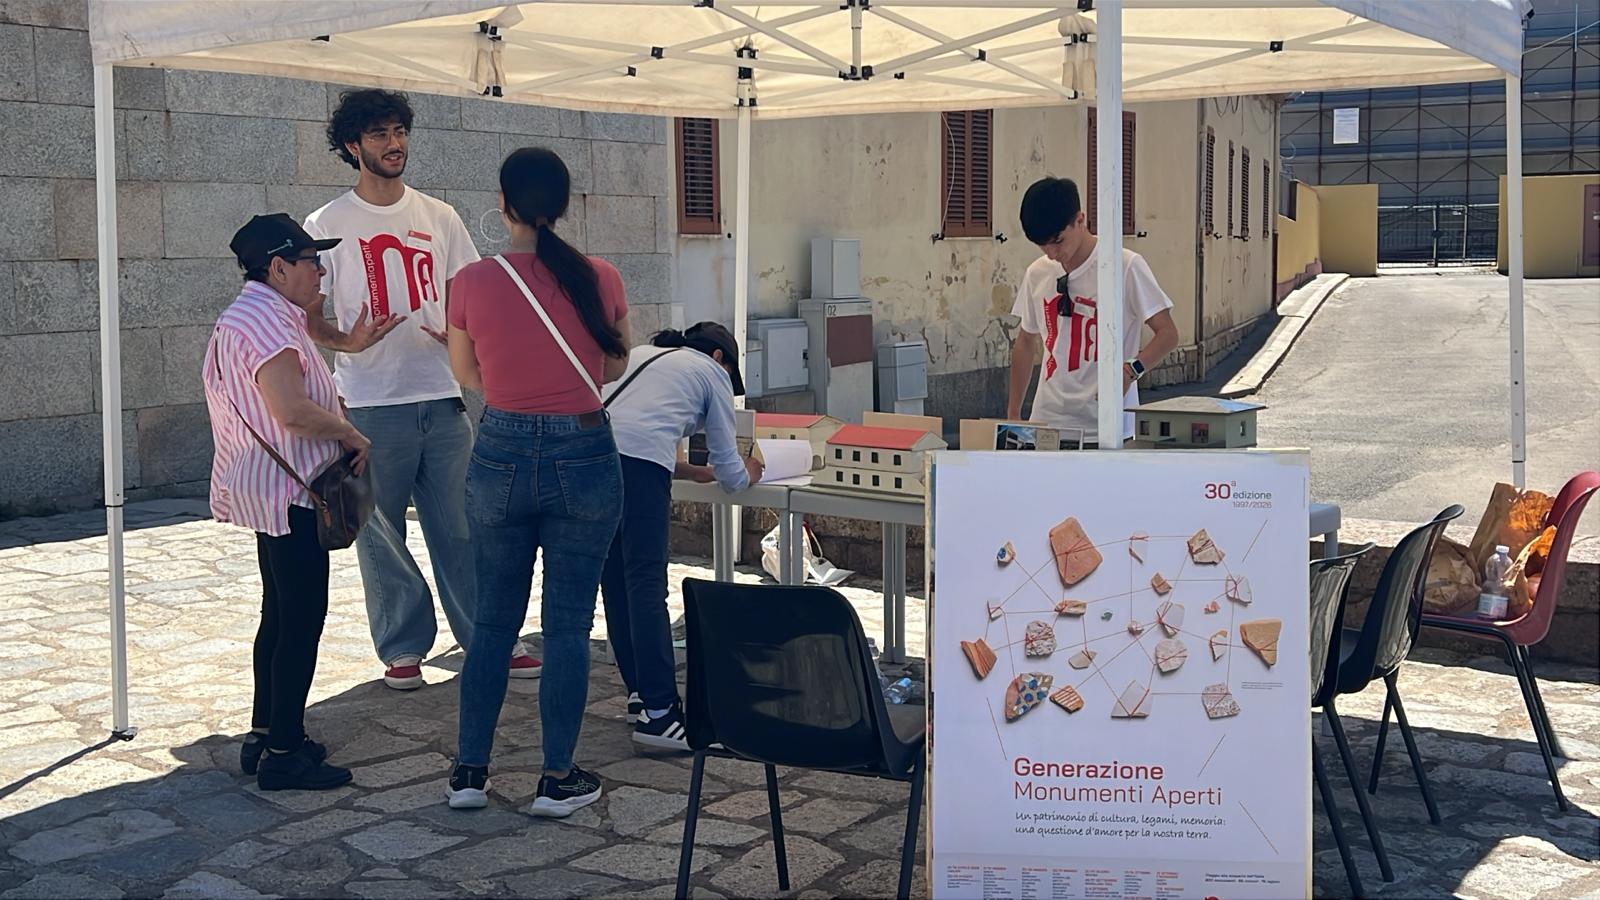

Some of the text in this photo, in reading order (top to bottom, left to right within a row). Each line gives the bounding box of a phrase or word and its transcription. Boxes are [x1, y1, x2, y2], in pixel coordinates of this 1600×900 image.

[361, 243, 381, 316] onumentiaperti
[1232, 490, 1272, 500] edizione
[1014, 757, 1164, 780] Generazione
[1015, 781, 1222, 809] Monumenti Aperti
[1015, 812, 1032, 820] Un
[1033, 811, 1087, 824] patrimonio
[1088, 812, 1098, 822] di
[1100, 813, 1139, 824] cultura,
[1141, 814, 1178, 827] legami,
[1015, 825, 1212, 840] una questione d'amore per la nostra terra.
